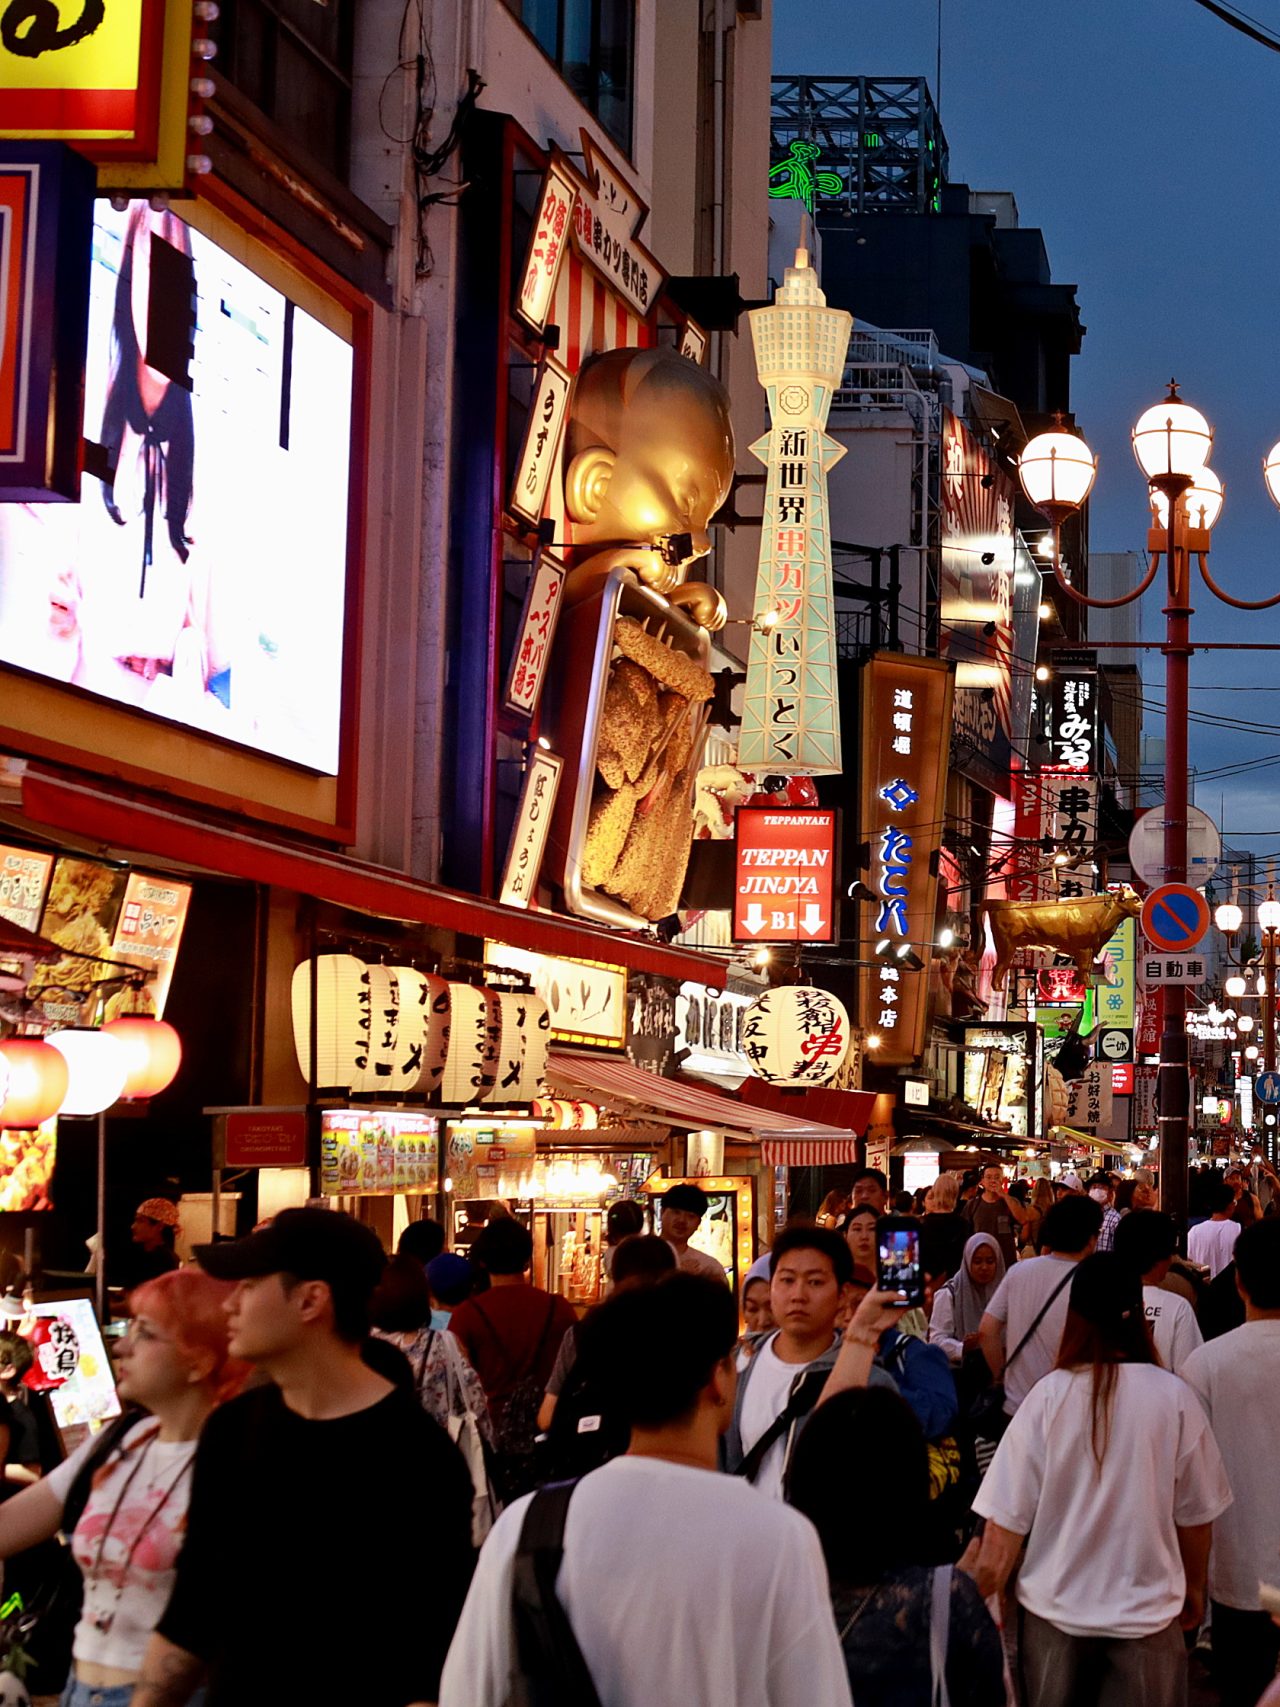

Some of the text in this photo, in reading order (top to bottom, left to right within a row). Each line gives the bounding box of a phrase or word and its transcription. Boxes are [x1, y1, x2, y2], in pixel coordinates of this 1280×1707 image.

[772, 429, 808, 761] 新世界串カツいっとく
[892, 688, 913, 755] 道頓堀
[764, 815, 830, 826] TEPPANYAKI
[511, 774, 548, 894] 紅しょうが
[741, 849, 830, 867] TEPPAN
[739, 876, 820, 895] JINJYA
[770, 911, 796, 930] B1
[1145, 960, 1204, 979] 自動車
[1105, 1040, 1128, 1052] 一休
[1086, 1070, 1102, 1124] お好み焼
[1145, 1306, 1162, 1317] CE
